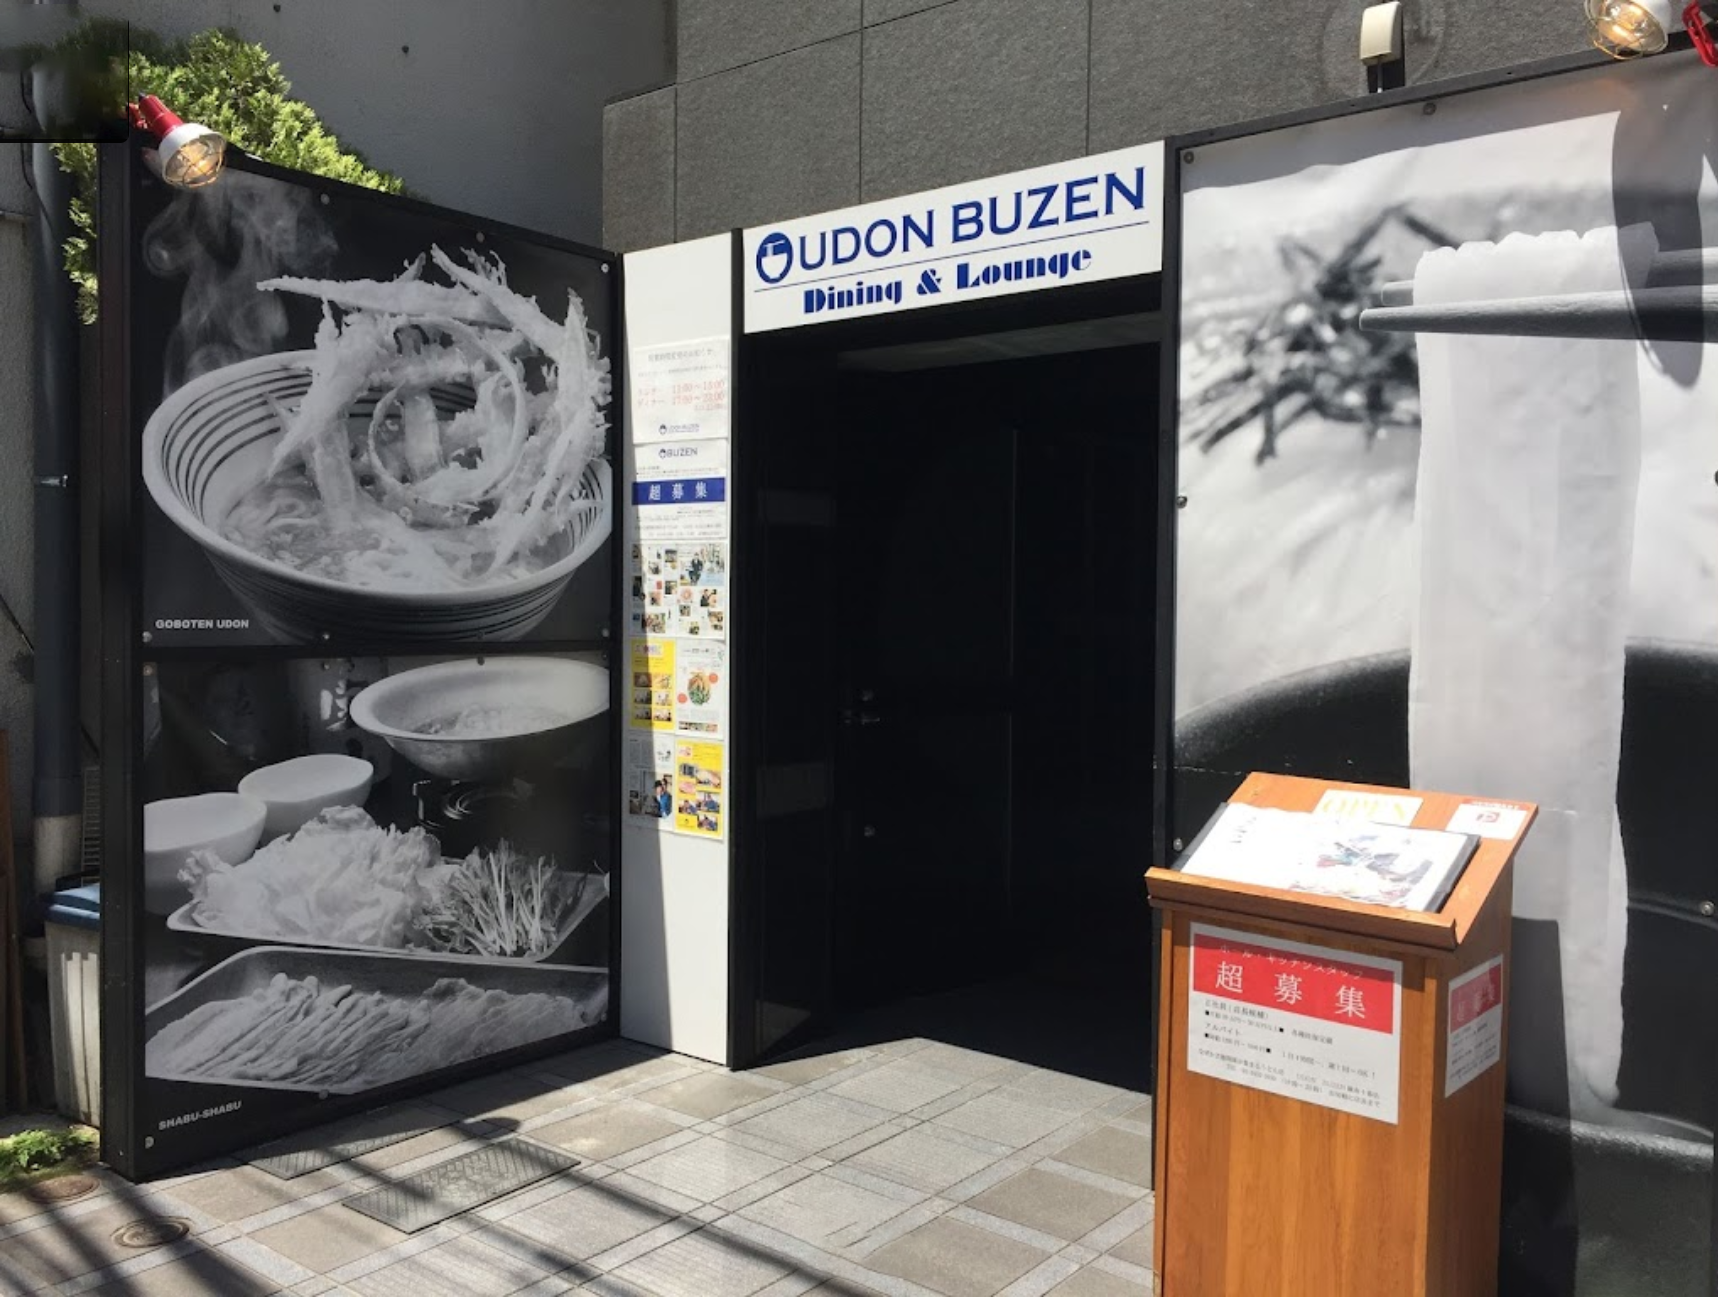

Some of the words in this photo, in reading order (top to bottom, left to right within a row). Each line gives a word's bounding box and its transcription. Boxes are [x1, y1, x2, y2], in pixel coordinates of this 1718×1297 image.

[799, 209, 935, 271] UDON
[952, 165, 1146, 244] BUZEN
[804, 279, 902, 314] Dining
[916, 268, 943, 296] &
[956, 248, 1093, 290] Lounge
[666, 447, 698, 458] BUZEN
[155, 619, 214, 629] GOBOTEN
[216, 619, 249, 629] UDON
[1215, 960, 1366, 1019] 超募集
[158, 1099, 242, 1131] SHABU-SHABU
